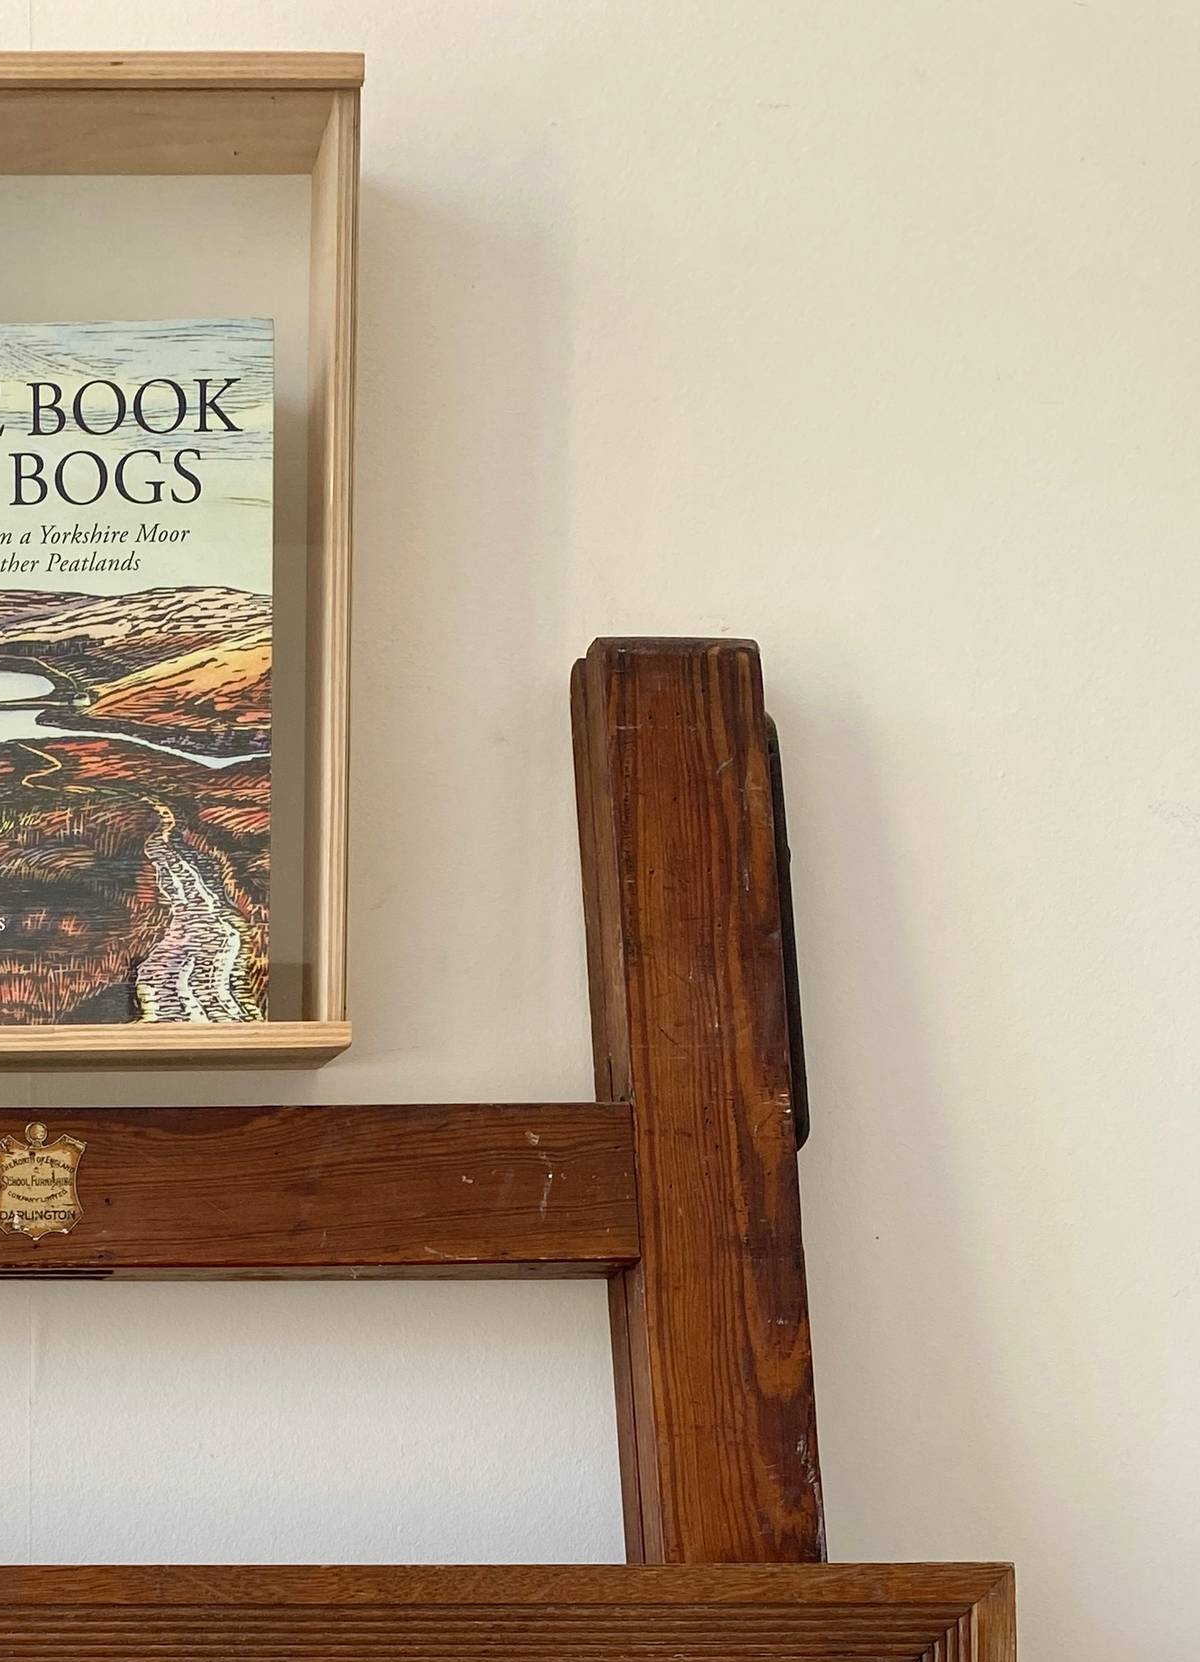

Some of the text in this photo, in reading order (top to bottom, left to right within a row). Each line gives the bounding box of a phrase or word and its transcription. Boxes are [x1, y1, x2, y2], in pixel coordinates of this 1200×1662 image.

[26, 377, 244, 437] BOOK
[9, 448, 203, 506] BOGS
[19, 532, 32, 545] a
[39, 522, 130, 546] Yorkshire
[136, 522, 191, 544] Moor
[45, 550, 141, 573] Peatlands
[0, 1210, 76, 1221] DARLINGTON
